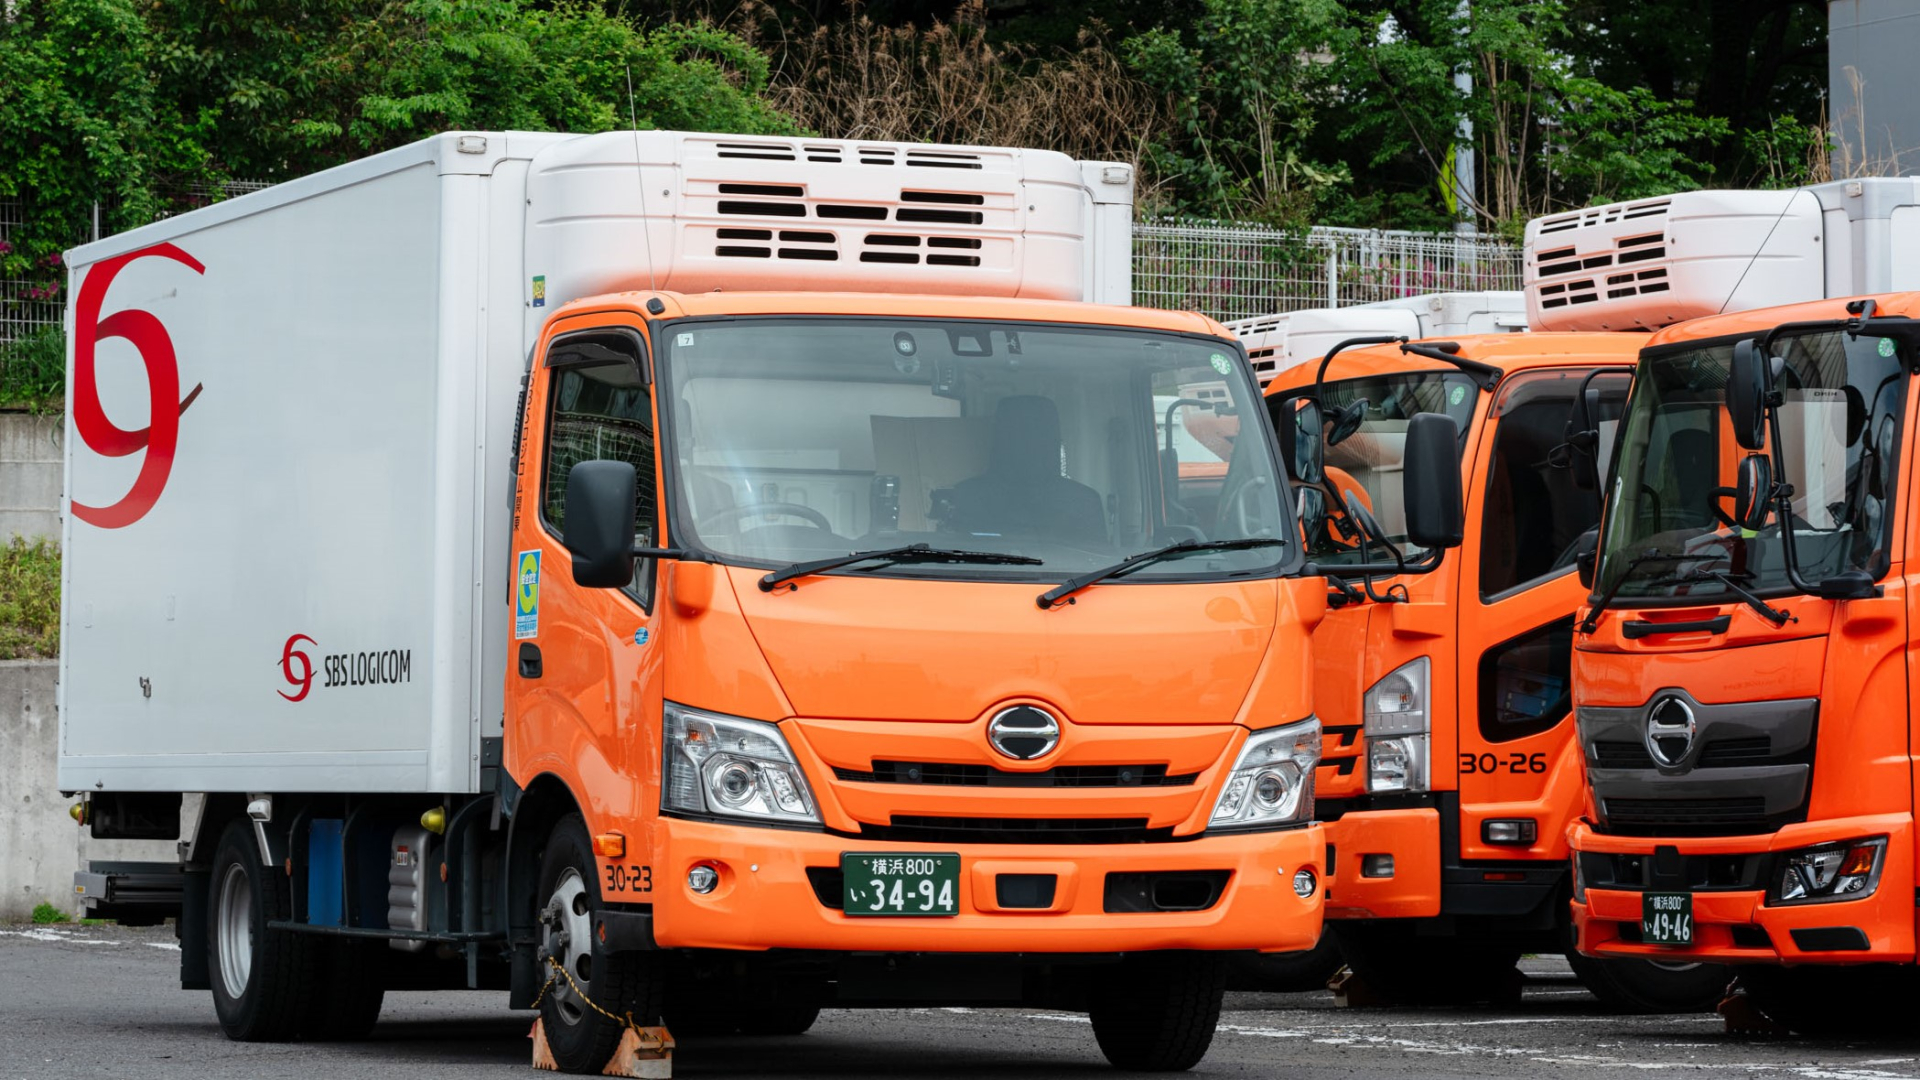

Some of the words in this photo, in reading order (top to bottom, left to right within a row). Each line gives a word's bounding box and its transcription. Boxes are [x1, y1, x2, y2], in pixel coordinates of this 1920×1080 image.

[684, 337, 690, 345] 7
[324, 654, 348, 688] SBS
[350, 649, 411, 686] LOGICOM
[1459, 752, 1547, 774] 30-26
[605, 865, 653, 892] 30-23
[872, 858, 935, 876] 横浜800
[850, 887, 866, 903] い
[869, 879, 954, 912] 34-94
[1653, 896, 1682, 910] 横浜800
[1652, 913, 1690, 941] 49-46
